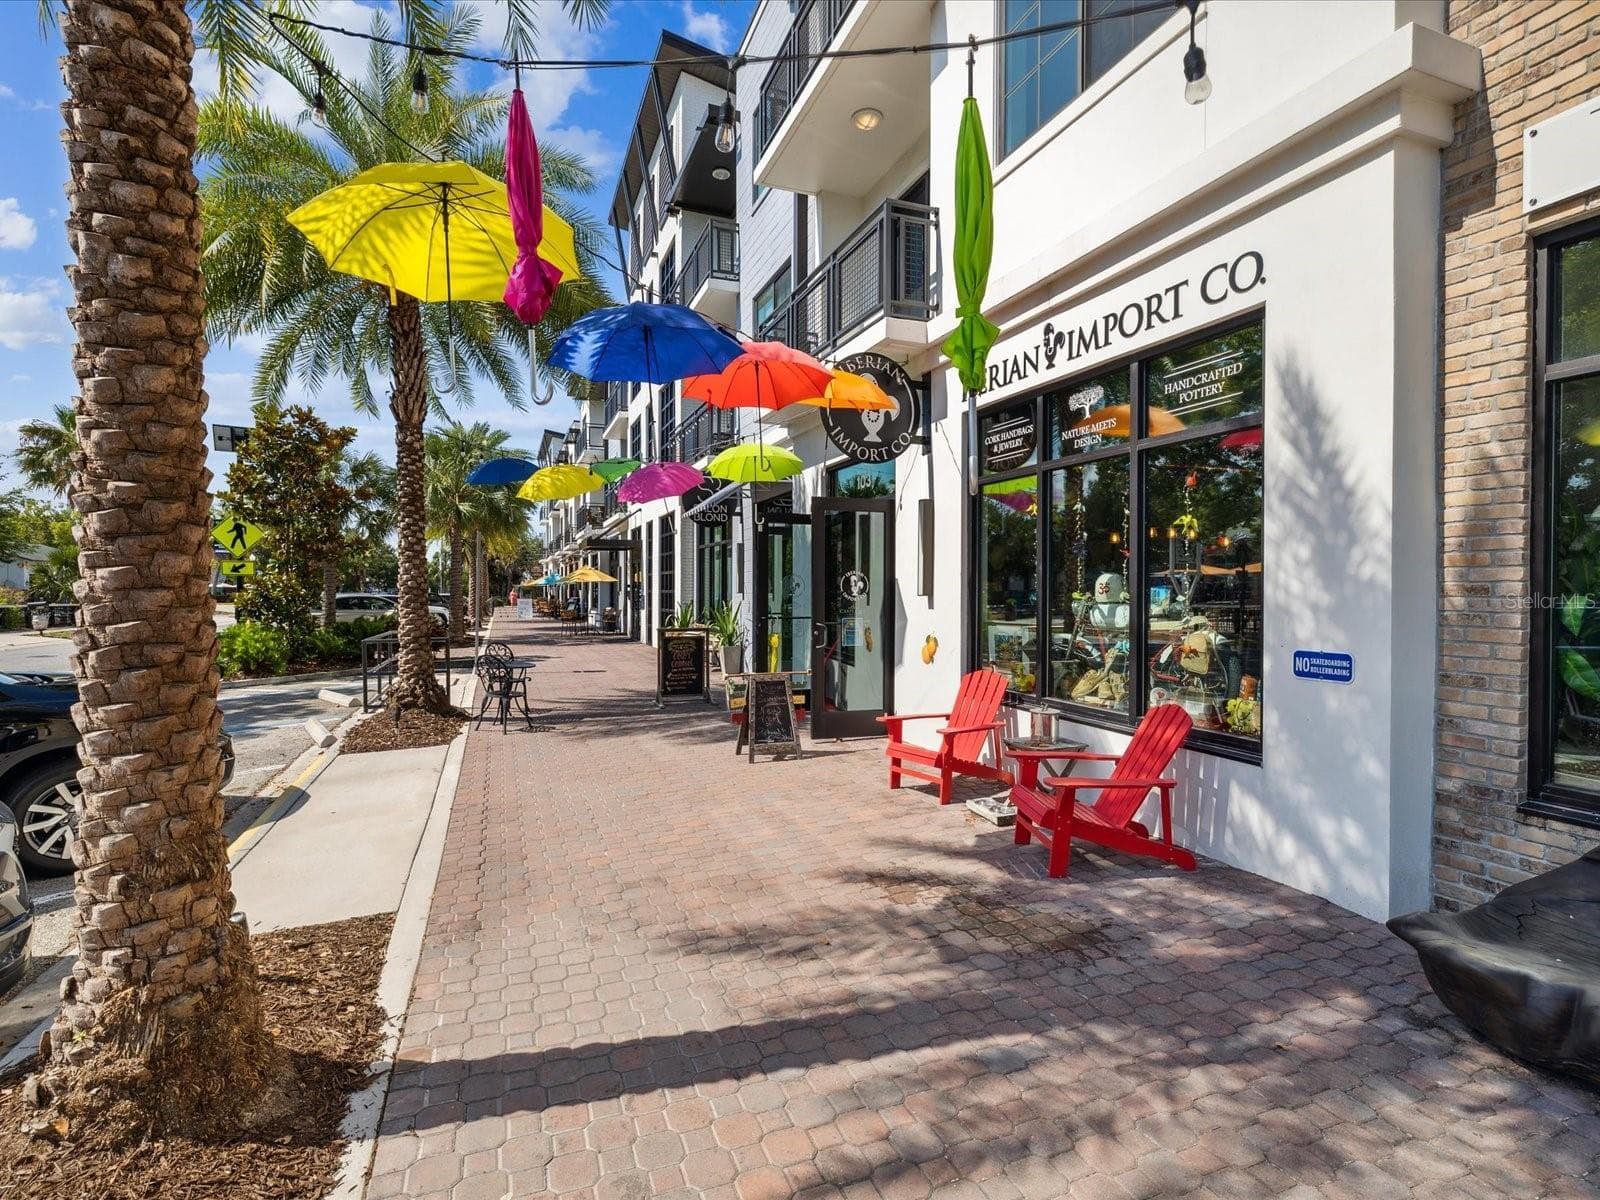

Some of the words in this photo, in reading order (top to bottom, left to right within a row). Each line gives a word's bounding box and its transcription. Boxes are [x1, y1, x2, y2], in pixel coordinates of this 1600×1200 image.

[1067, 279, 1189, 361] IMPORT
[1200, 251, 1267, 304] CO.
[1164, 362, 1242, 394] HANDCRAFTED
[1179, 381, 1225, 404] POTTERY
[984, 433, 1001, 446] CORK
[1000, 424, 1034, 441] HANDBAGS
[1062, 424, 1090, 440] NATURE
[1089, 418, 1117, 432] MEETS
[831, 427, 889, 461] IMPORT
[998, 437, 1024, 453] JEWELRY
[1074, 434, 1102, 448] DESIGN
[693, 504, 728, 513] LON
[693, 513, 728, 522] BLOND
[1295, 656, 1310, 672] NO
[1310, 657, 1350, 668] SKATEBOARDING
[1310, 666, 1350, 677] ROLLERBLADING
